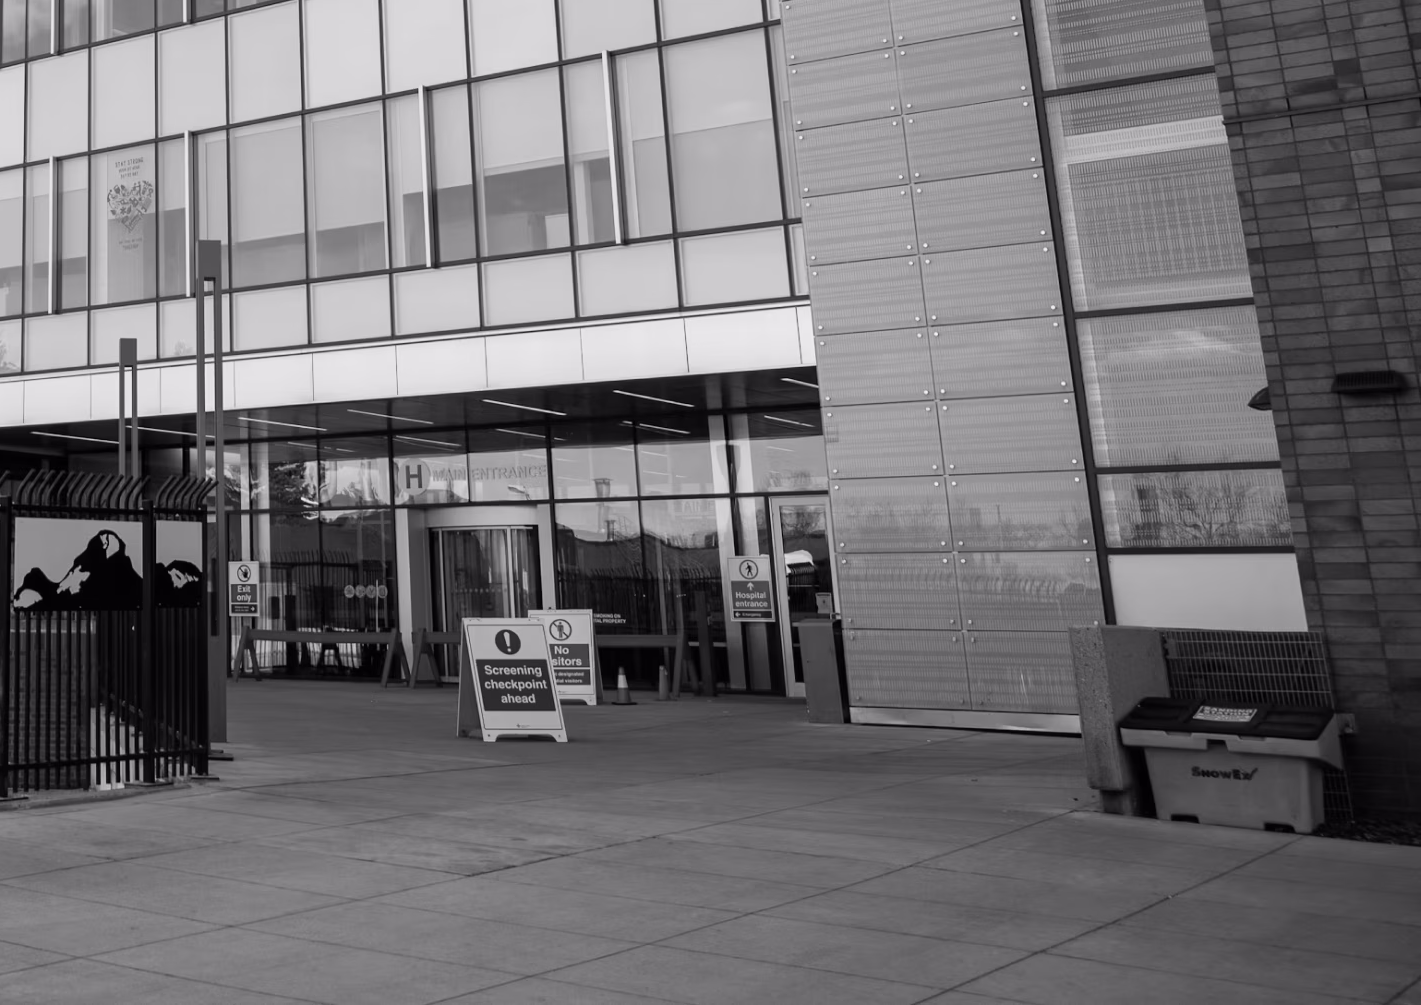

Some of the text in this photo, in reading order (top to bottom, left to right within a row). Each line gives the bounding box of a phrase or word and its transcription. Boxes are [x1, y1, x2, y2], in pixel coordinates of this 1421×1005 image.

[127, 157, 144, 165] STRONG
[405, 464, 547, 489] H MAIN ENTRANCE
[237, 585, 251, 593] Exit
[236, 594, 252, 603] only
[735, 591, 767, 600] Hospital
[735, 600, 768, 608] entrance
[554, 645, 569, 655] No
[552, 657, 582, 666] sitors
[484, 665, 543, 678] Screening
[484, 679, 548, 691] checkpoint
[501, 693, 536, 704] ahead
